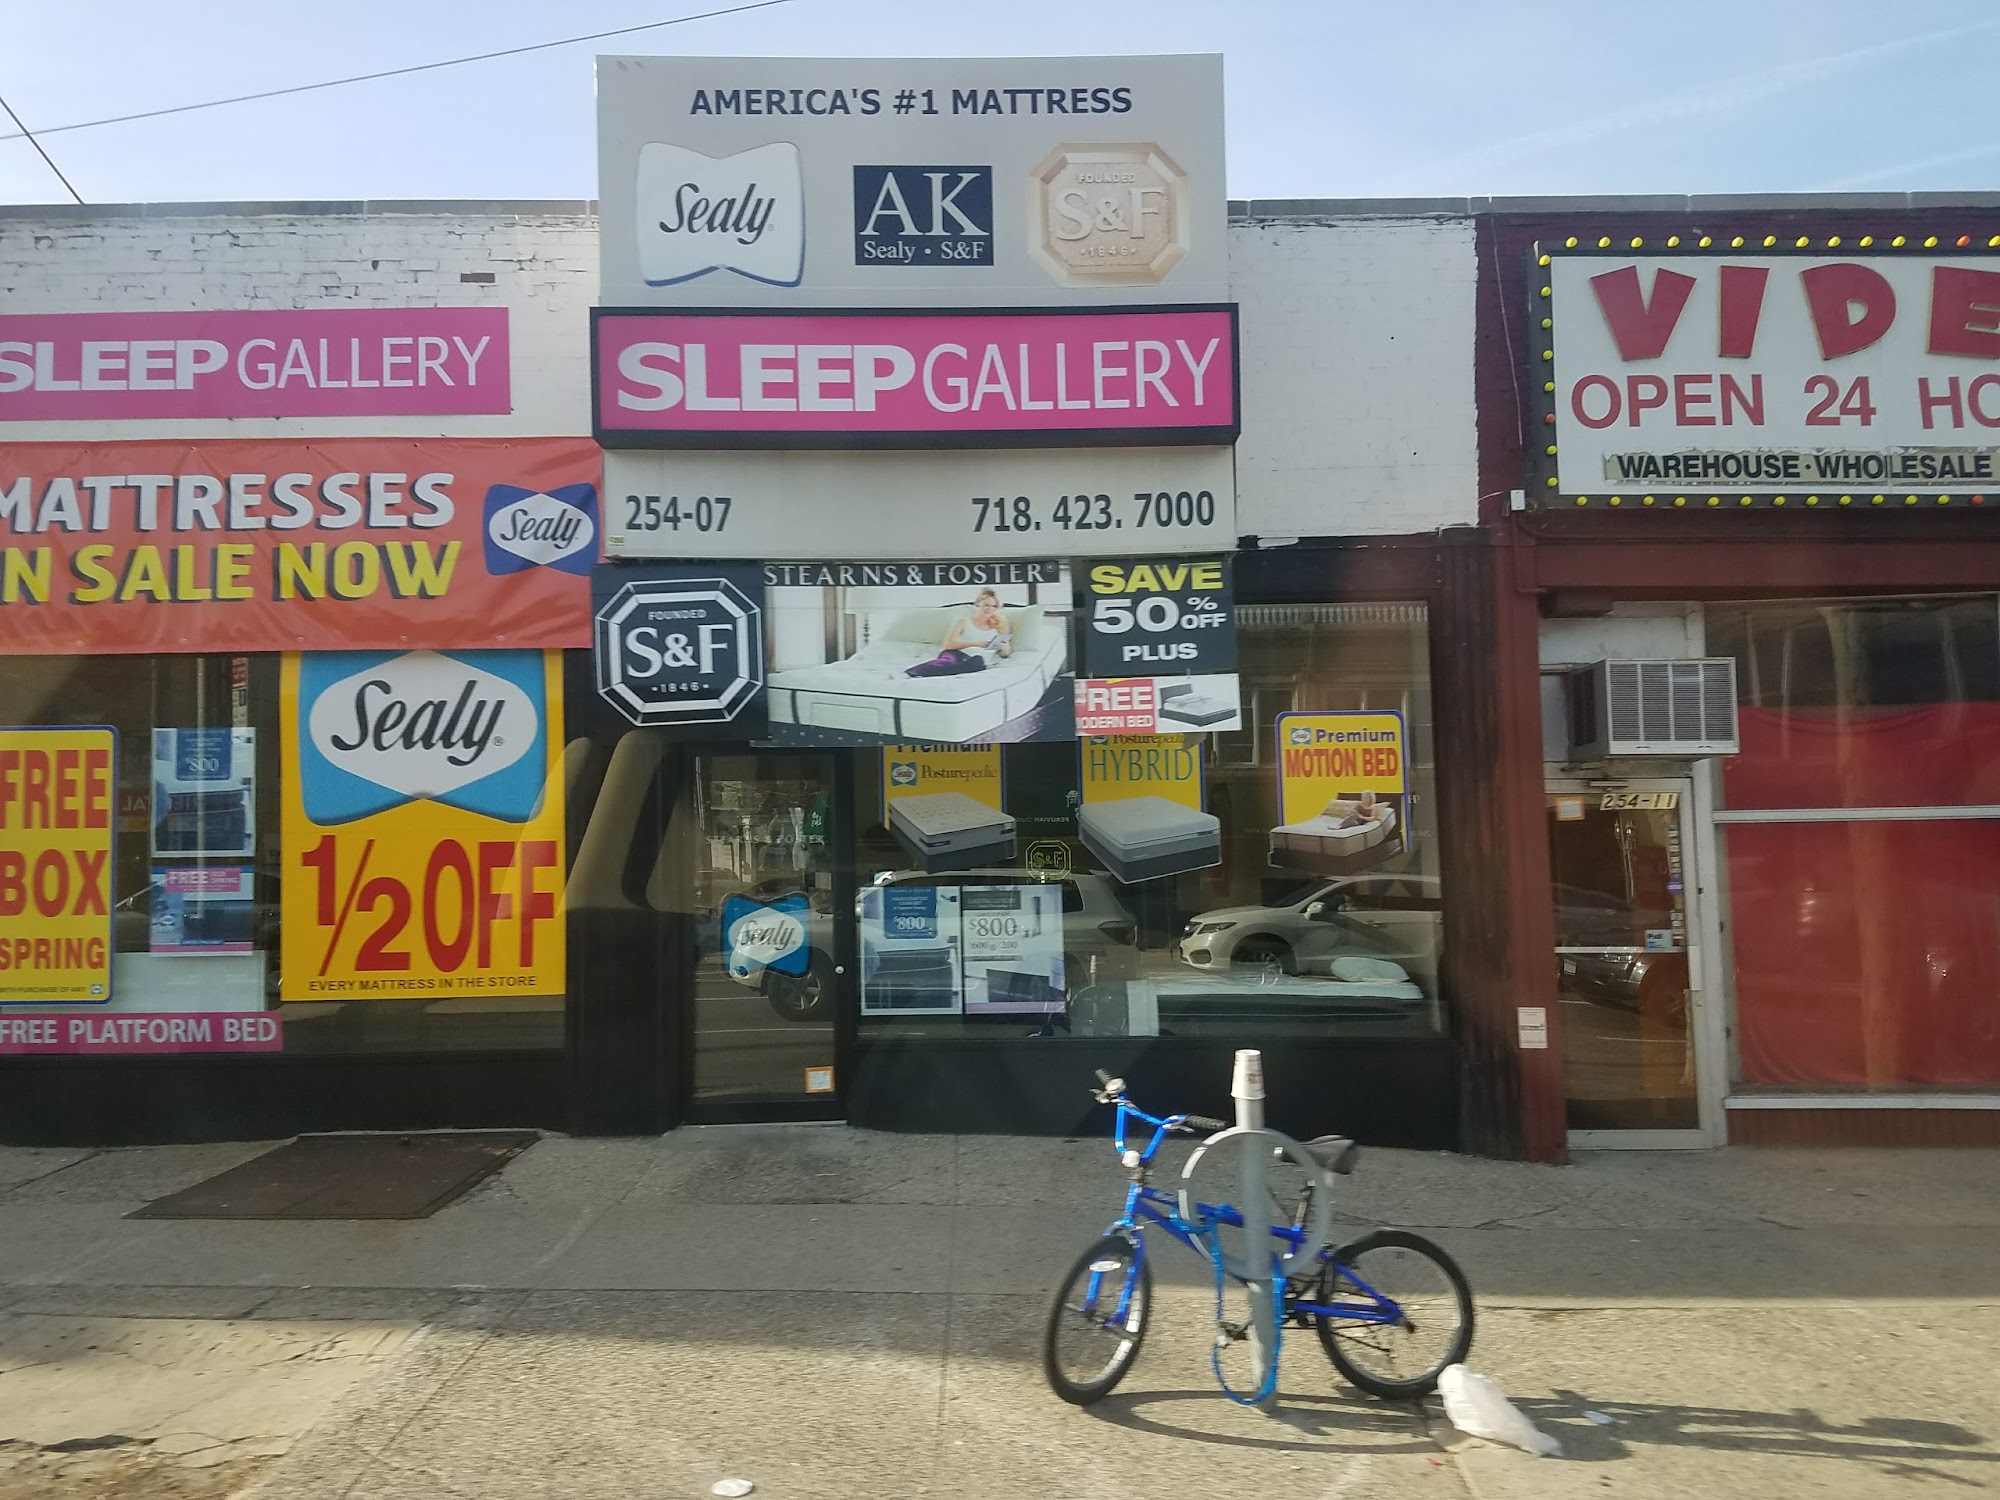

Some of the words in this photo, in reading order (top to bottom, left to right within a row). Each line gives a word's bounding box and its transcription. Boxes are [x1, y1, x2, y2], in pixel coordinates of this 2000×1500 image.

[689, 88, 882, 116] AMERICA'S
[893, 88, 940, 116] #1
[951, 87, 1133, 116] MATTRESS
[1077, 173, 1137, 184] FOUNDED
[659, 182, 776, 246] Sealy
[859, 171, 991, 236] AK
[1054, 187, 1166, 242] S&F
[863, 240, 916, 264] Sealy
[940, 240, 986, 260] S&F
[1589, 262, 2000, 362] VIDE
[0, 340, 229, 393] SLEEP
[237, 335, 492, 390] GALLERY
[617, 341, 916, 412] SLEEP
[922, 337, 1221, 413] GALLERY
[1571, 373, 1766, 430] OPEN
[1803, 375, 1877, 427] 24
[1617, 454, 1800, 479] WAREHOUSE
[1812, 454, 1993, 479] WHOLESALE
[625, 495, 733, 533] 254-07
[971, 496, 1041, 533] 718.
[1052, 494, 1123, 531] 423.
[1134, 490, 1216, 528] 7000
[499, 508, 582, 550] Sealy
[73, 542, 256, 603] SALE
[279, 540, 462, 601] NOW
[763, 563, 899, 586] STEARNS
[906, 563, 924, 585] &
[1089, 561, 1224, 595] SAVE
[648, 609, 707, 621] FOUNDED
[1091, 596, 1180, 634] 50
[1186, 596, 1219, 612] %
[1179, 612, 1227, 630] OFF
[625, 623, 734, 678] S&F
[1121, 642, 1199, 662] PLUS
[331, 680, 506, 767] Sealy
[1126, 714, 1154, 729] BED
[1315, 727, 1396, 743] Premium
[921, 764, 997, 782] Posturepedic
[1089, 748, 1195, 782] HYBRID
[1285, 748, 1358, 778] MOTION
[1363, 747, 1398, 777] BED
[0, 749, 109, 830] FREE
[1604, 794, 1673, 808] 254-11
[1033, 851, 1064, 868] S&F
[0, 848, 108, 918] BOX
[168, 871, 209, 884] FREE
[422, 838, 558, 973] OFF
[968, 917, 1018, 937] $800
[0, 937, 105, 970] SPRING
[309, 980, 356, 991] EVERY
[358, 978, 435, 990] MATTRESS
[438, 978, 454, 989] IN
[457, 977, 485, 988] THE
[488, 975, 538, 987] STORE
[0, 1019, 58, 1044] FREE
[68, 1018, 212, 1044] PLATFORM
[223, 1017, 278, 1043] BED
